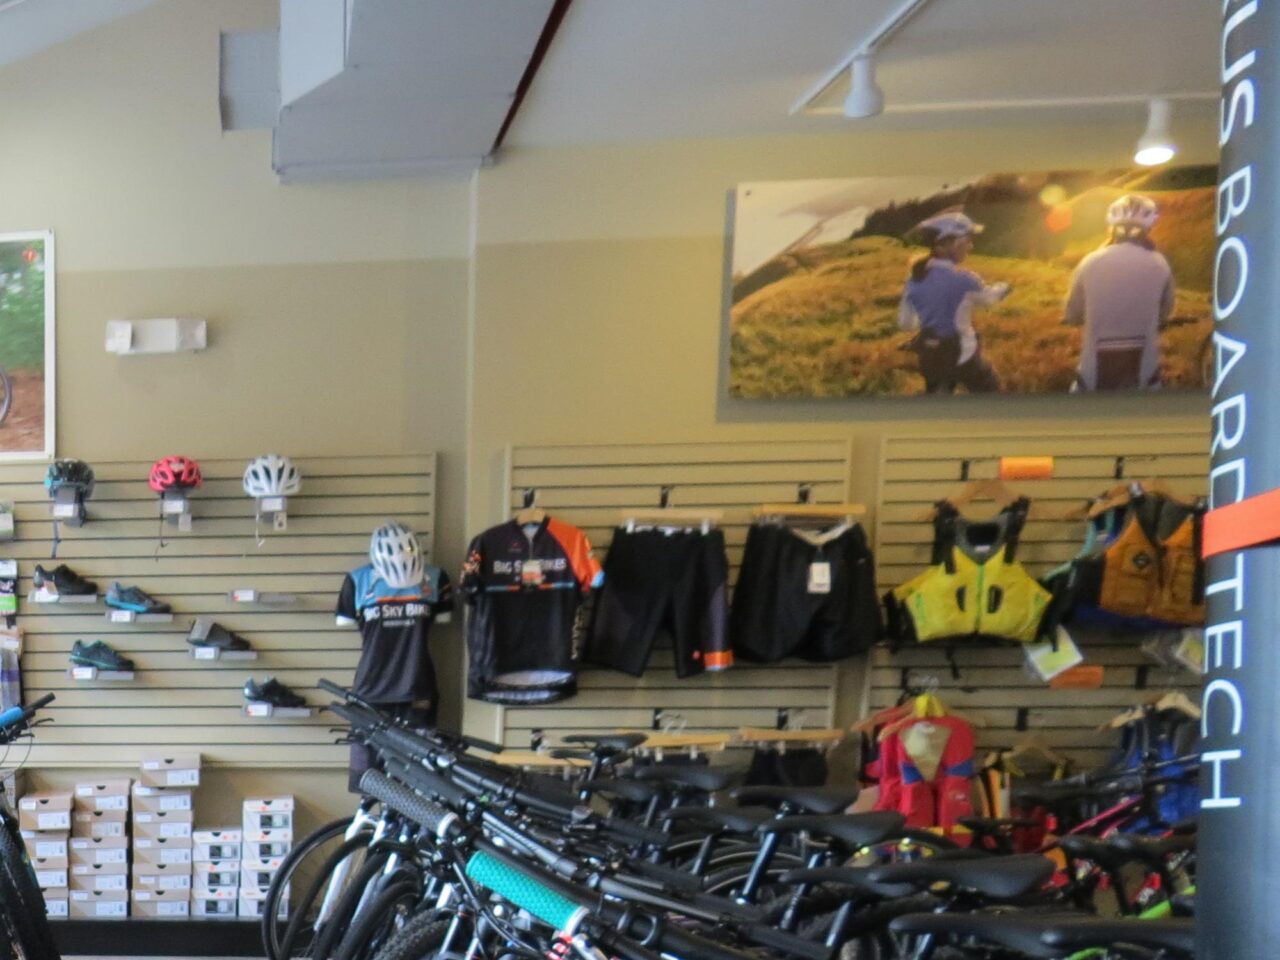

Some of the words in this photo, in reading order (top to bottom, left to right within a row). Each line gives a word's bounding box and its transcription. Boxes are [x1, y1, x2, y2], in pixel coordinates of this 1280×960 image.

[1219, 0, 1258, 149] US
[494, 559, 512, 574] BIG
[382, 604, 403, 618] SKY
[1201, 553, 1244, 809] TECH
